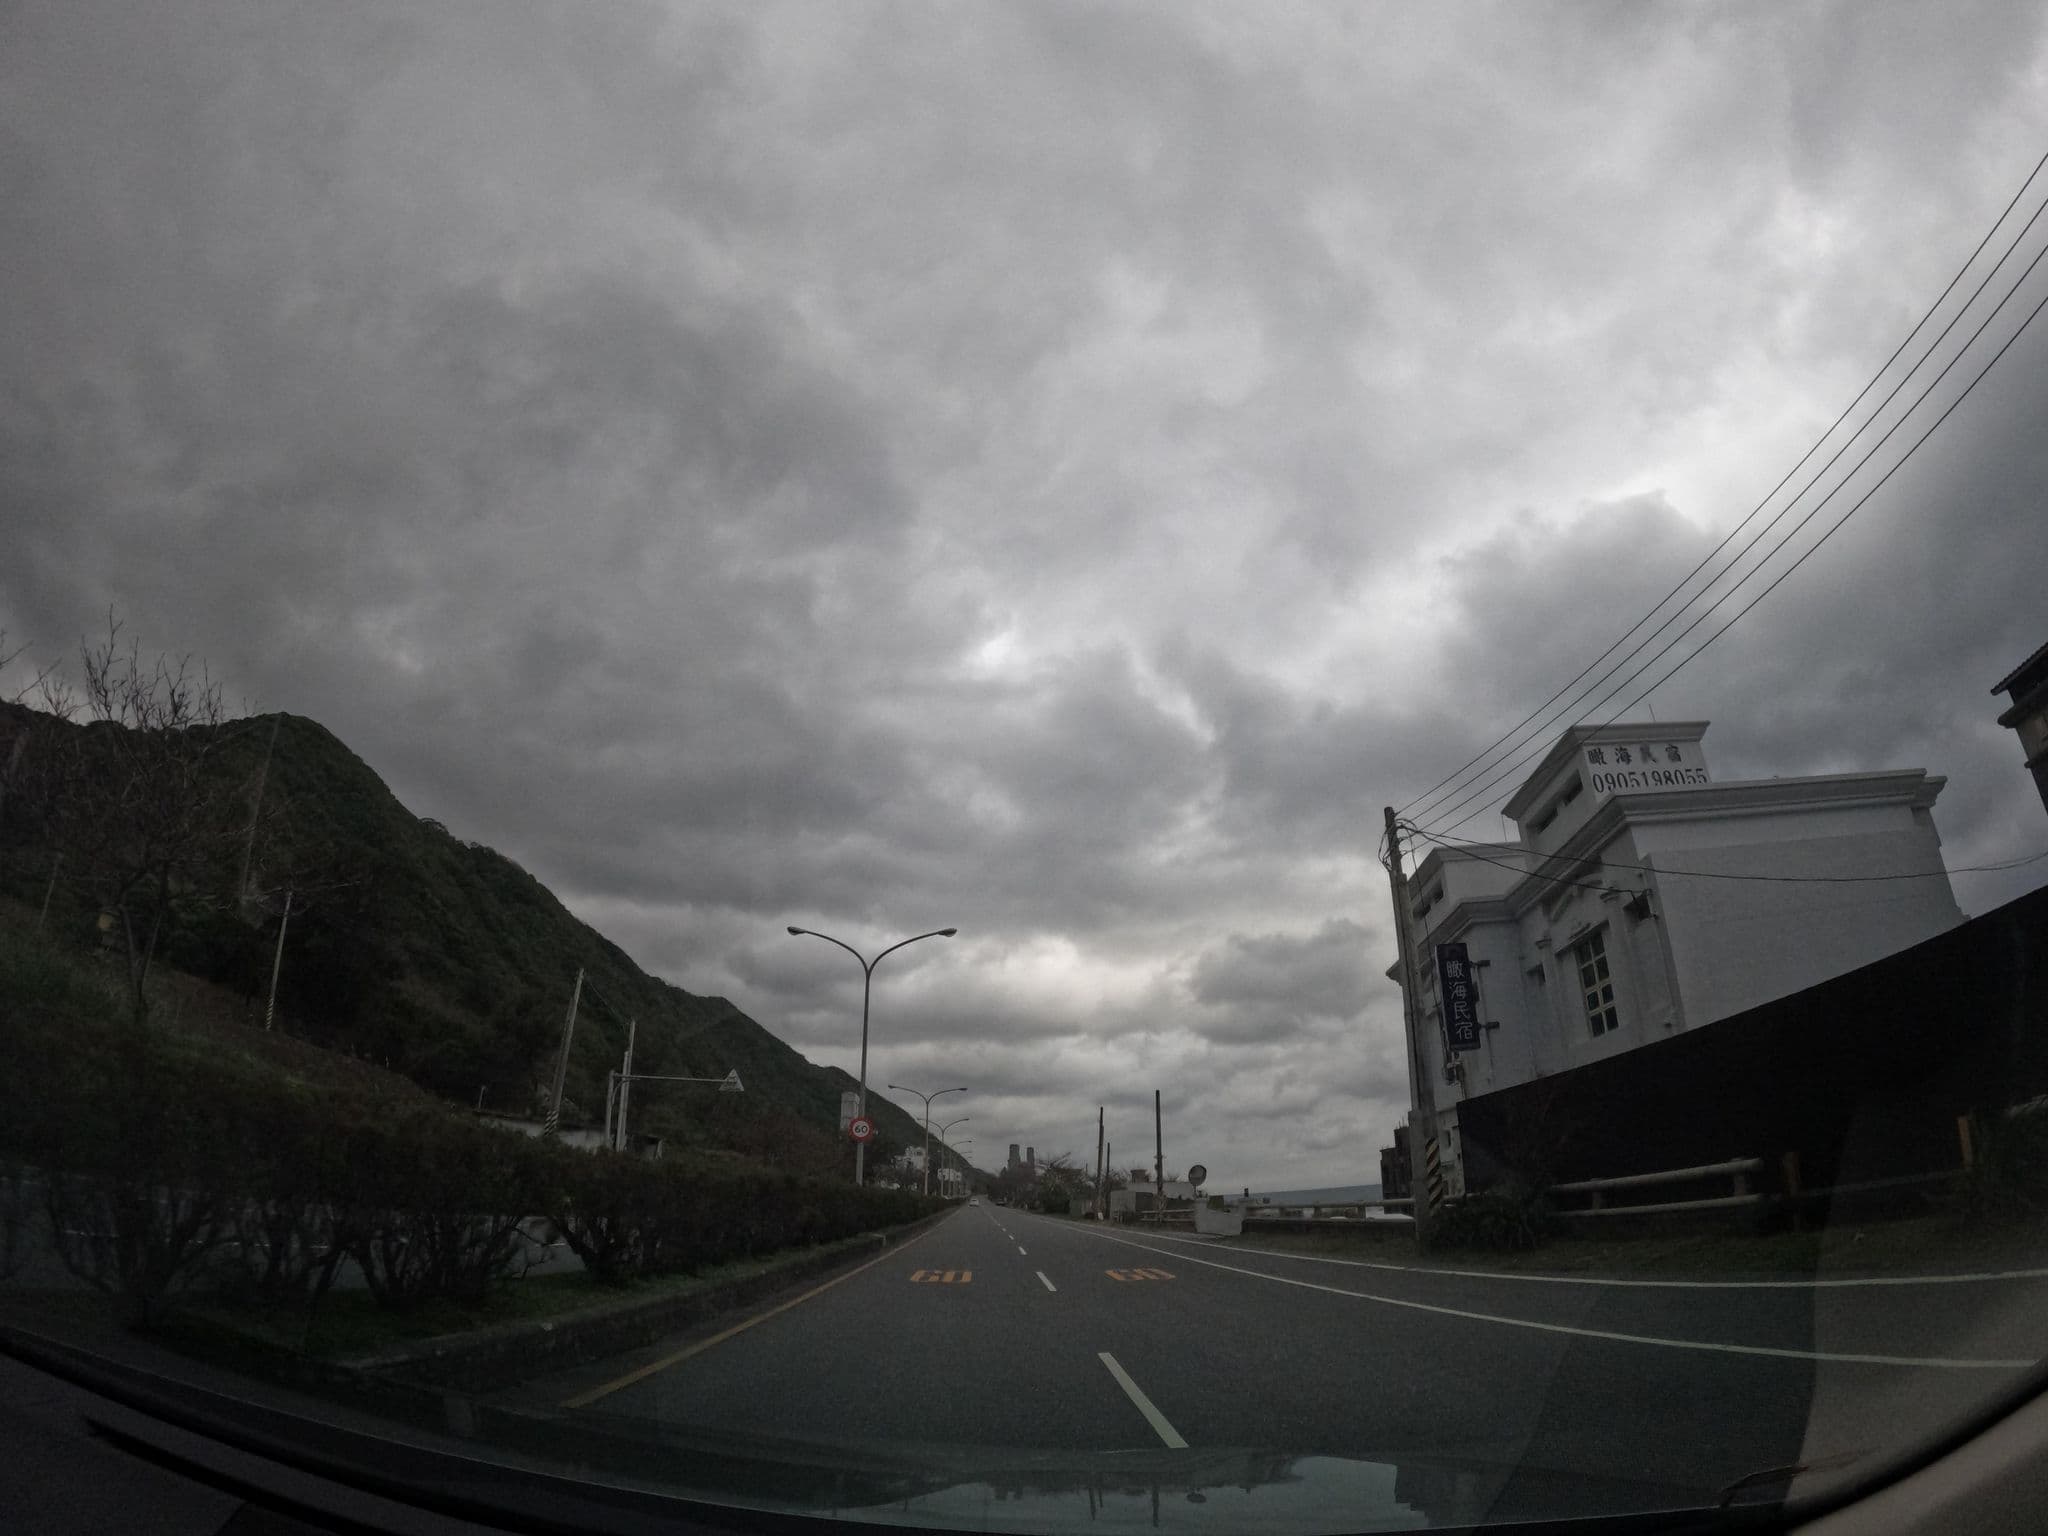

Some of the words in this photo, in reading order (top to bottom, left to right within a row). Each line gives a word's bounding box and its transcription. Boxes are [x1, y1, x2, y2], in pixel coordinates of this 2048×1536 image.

[1446, 960, 1473, 1040] 瞰海民宿
[855, 1125, 867, 1133] 60
